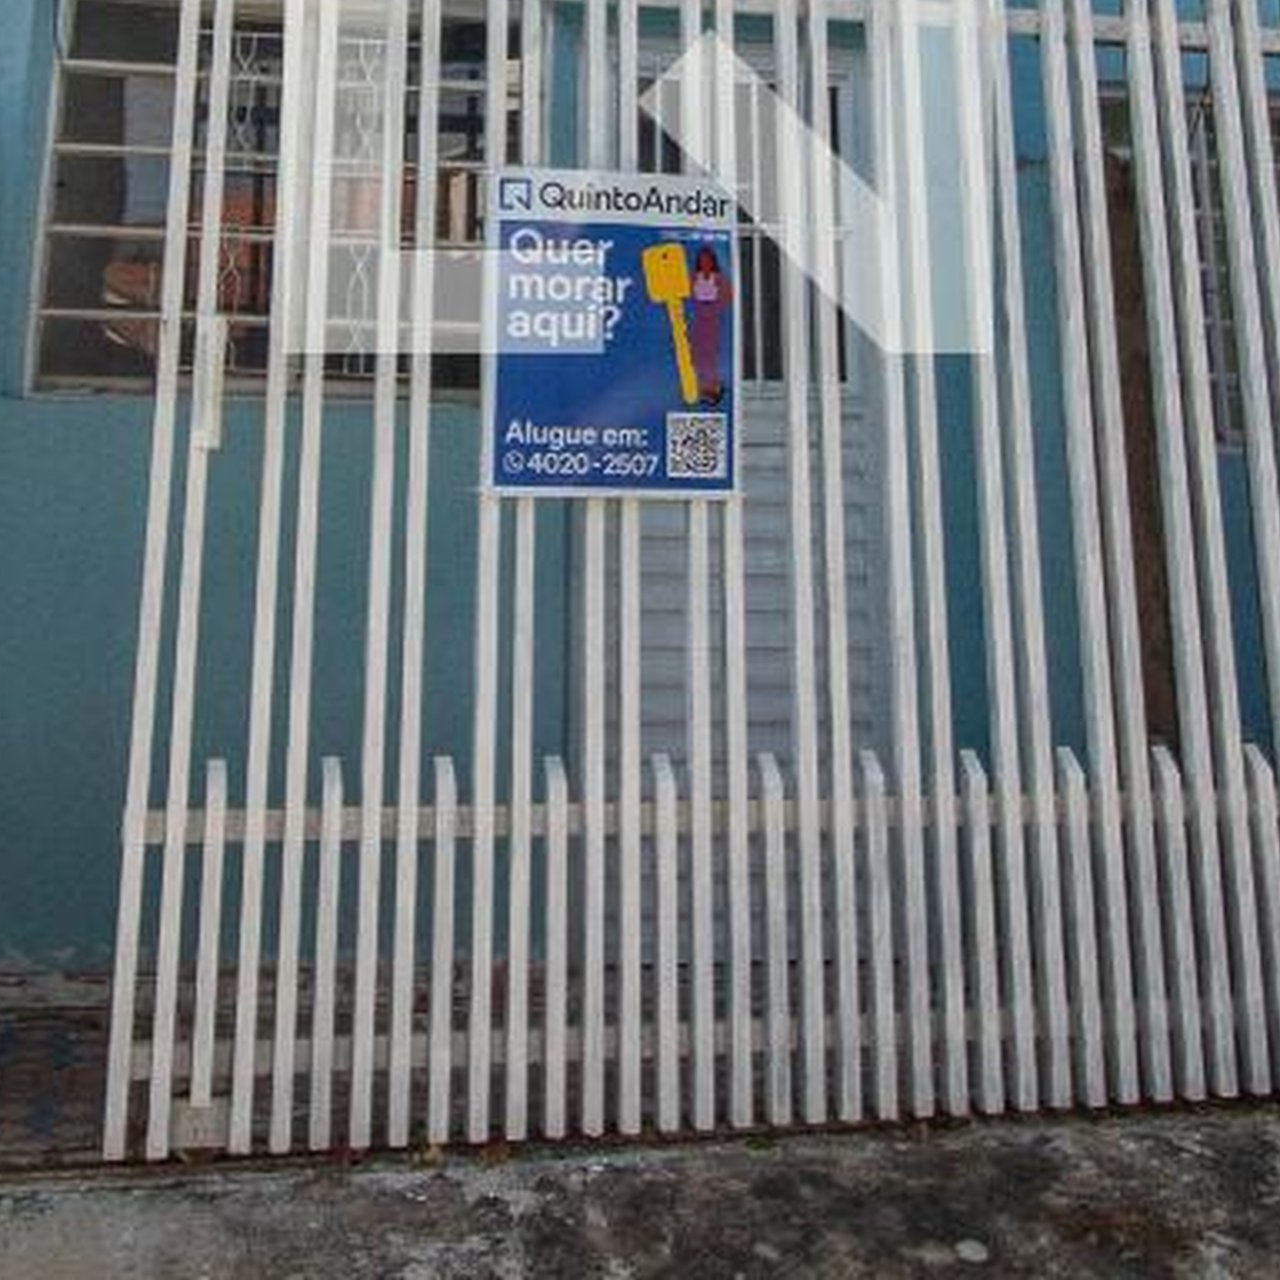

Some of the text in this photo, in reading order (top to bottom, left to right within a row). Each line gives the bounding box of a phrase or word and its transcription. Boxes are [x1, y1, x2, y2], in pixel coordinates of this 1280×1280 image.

[539, 182, 731, 218] QuintoAndar
[509, 228, 615, 267] Quer
[508, 272, 633, 303] morar
[506, 304, 622, 347] aqui?
[505, 419, 649, 451] Alugue em:
